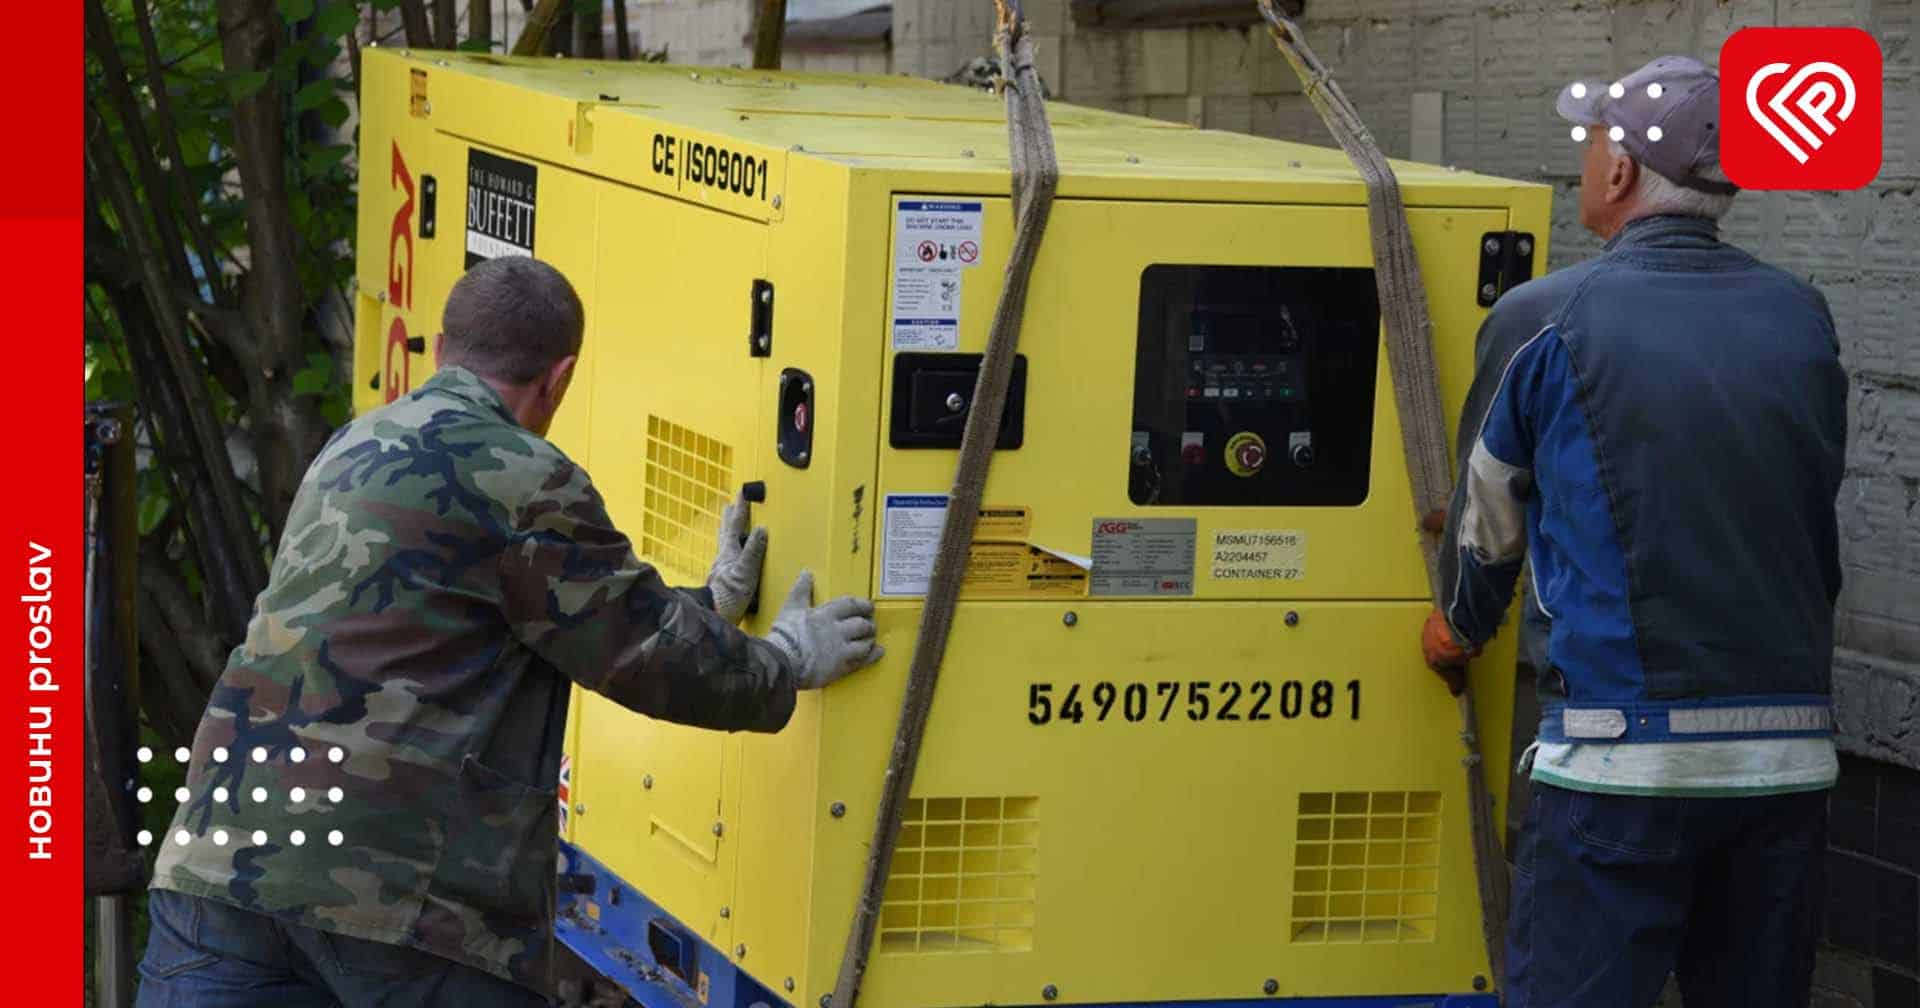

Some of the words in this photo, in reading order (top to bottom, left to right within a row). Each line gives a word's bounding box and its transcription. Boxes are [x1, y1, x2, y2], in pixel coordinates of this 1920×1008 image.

[652, 133, 676, 176] CE
[685, 140, 768, 201] ISO9001
[467, 185, 535, 248] BUFFETT
[1097, 521, 1128, 535] AGG
[1215, 551, 1268, 561] A2204457
[1214, 567, 1282, 579] CONTAINER
[1284, 567, 1299, 579] 27
[1027, 679, 1362, 726] 54907522081
